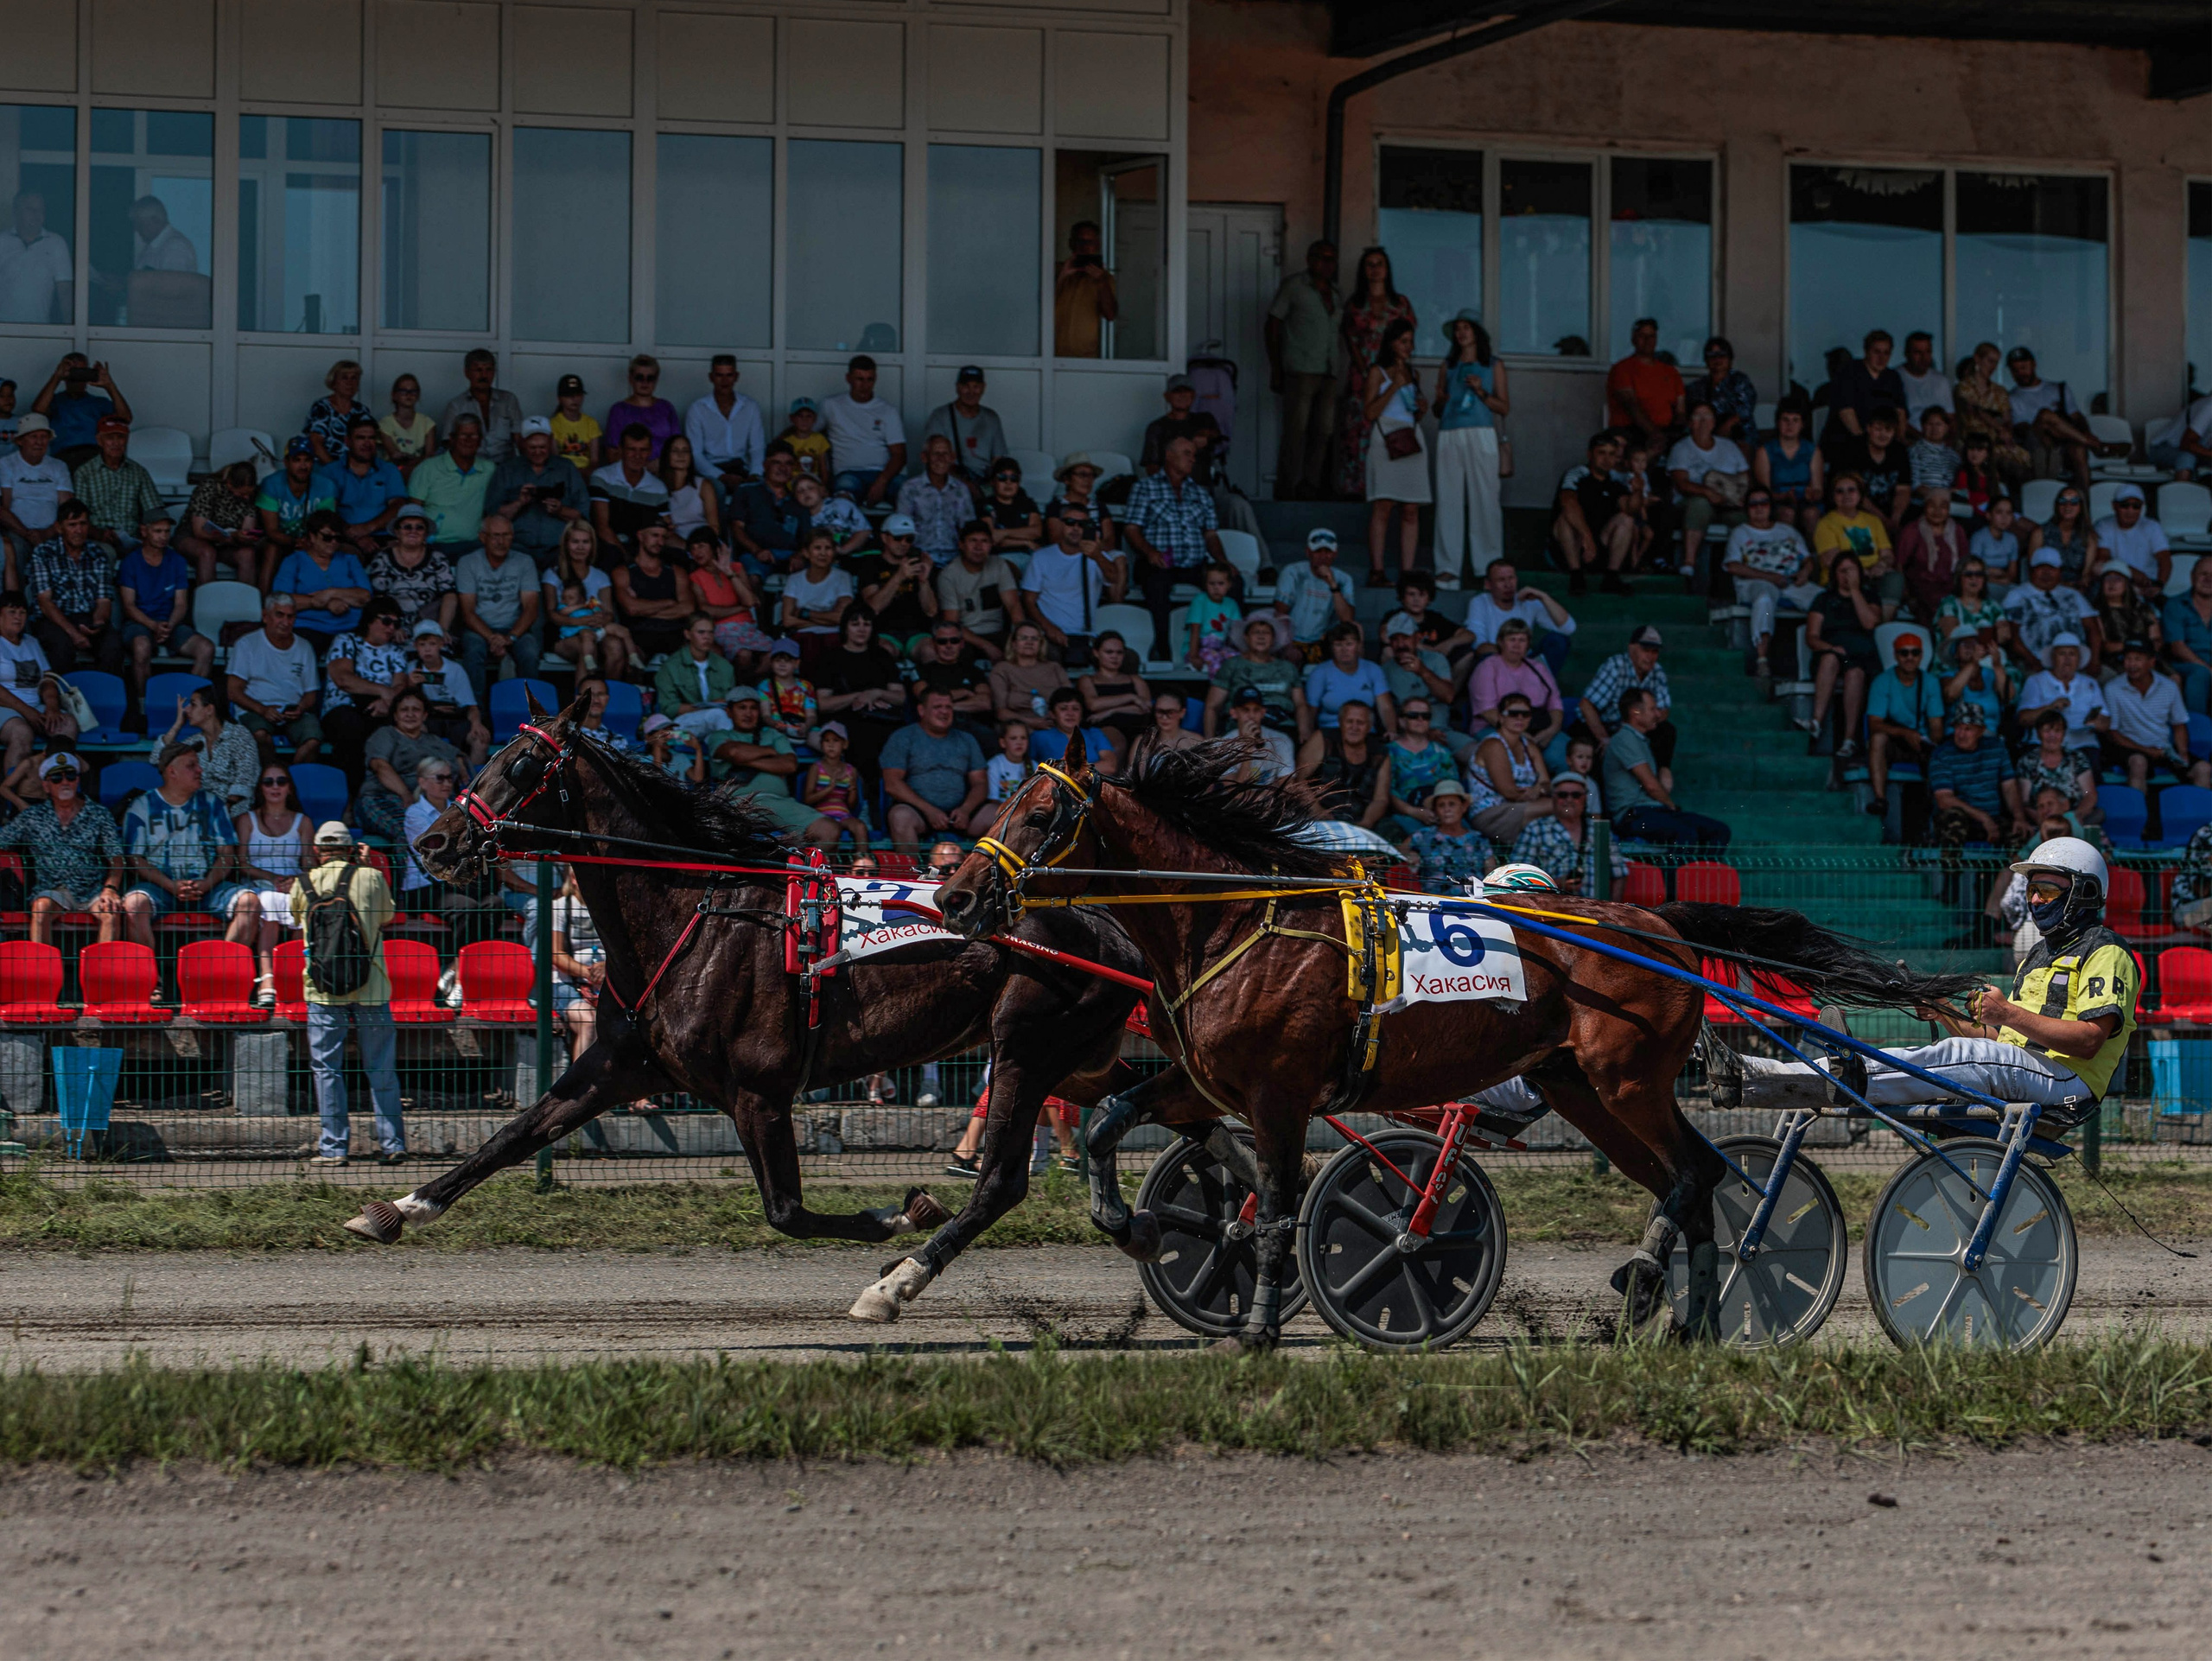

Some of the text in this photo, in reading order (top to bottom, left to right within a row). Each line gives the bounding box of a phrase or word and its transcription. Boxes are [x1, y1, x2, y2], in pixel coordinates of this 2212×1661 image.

[856, 922, 951, 949] Хакаси
[1428, 907, 1485, 967] 6
[1410, 974, 1511, 995] Хакасия
